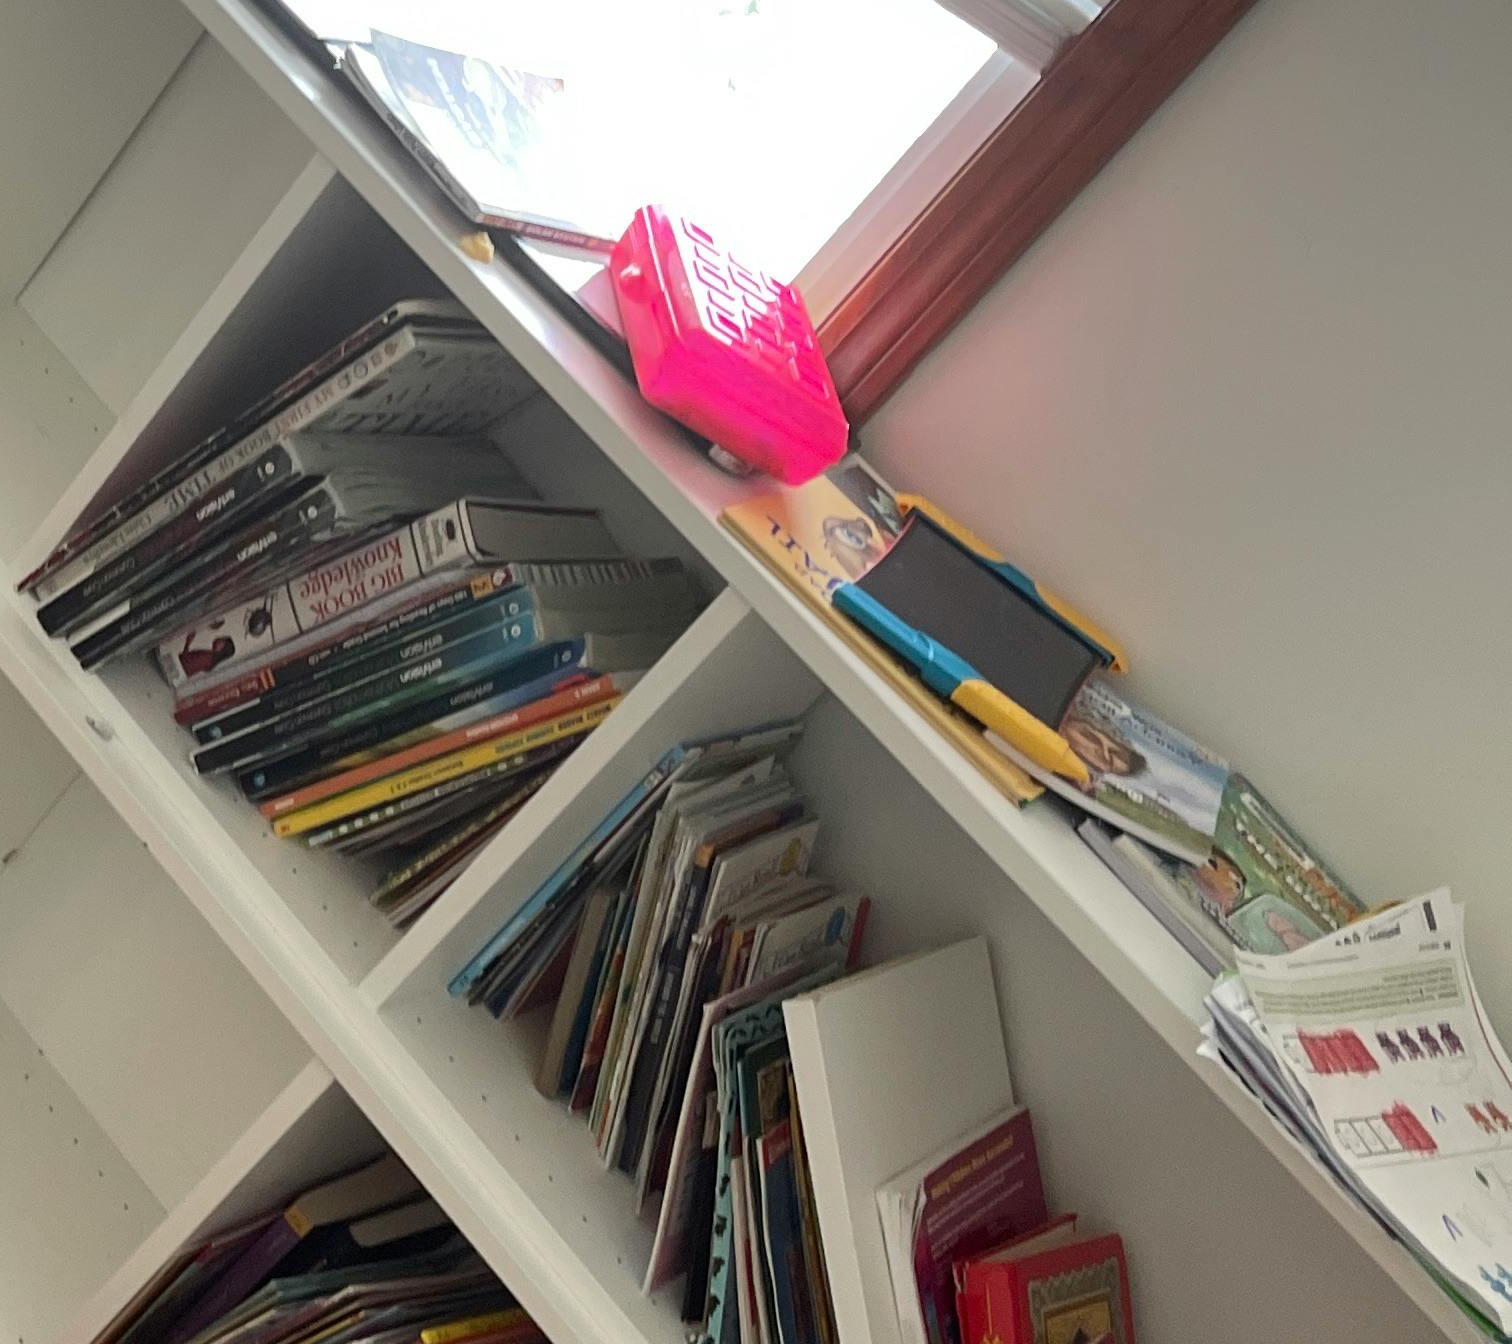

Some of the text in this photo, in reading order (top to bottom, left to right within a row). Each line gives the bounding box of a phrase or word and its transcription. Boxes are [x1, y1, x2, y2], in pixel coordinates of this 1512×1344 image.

[297, 537, 403, 601] Knowledge
[309, 563, 405, 624] BIG BOOK
